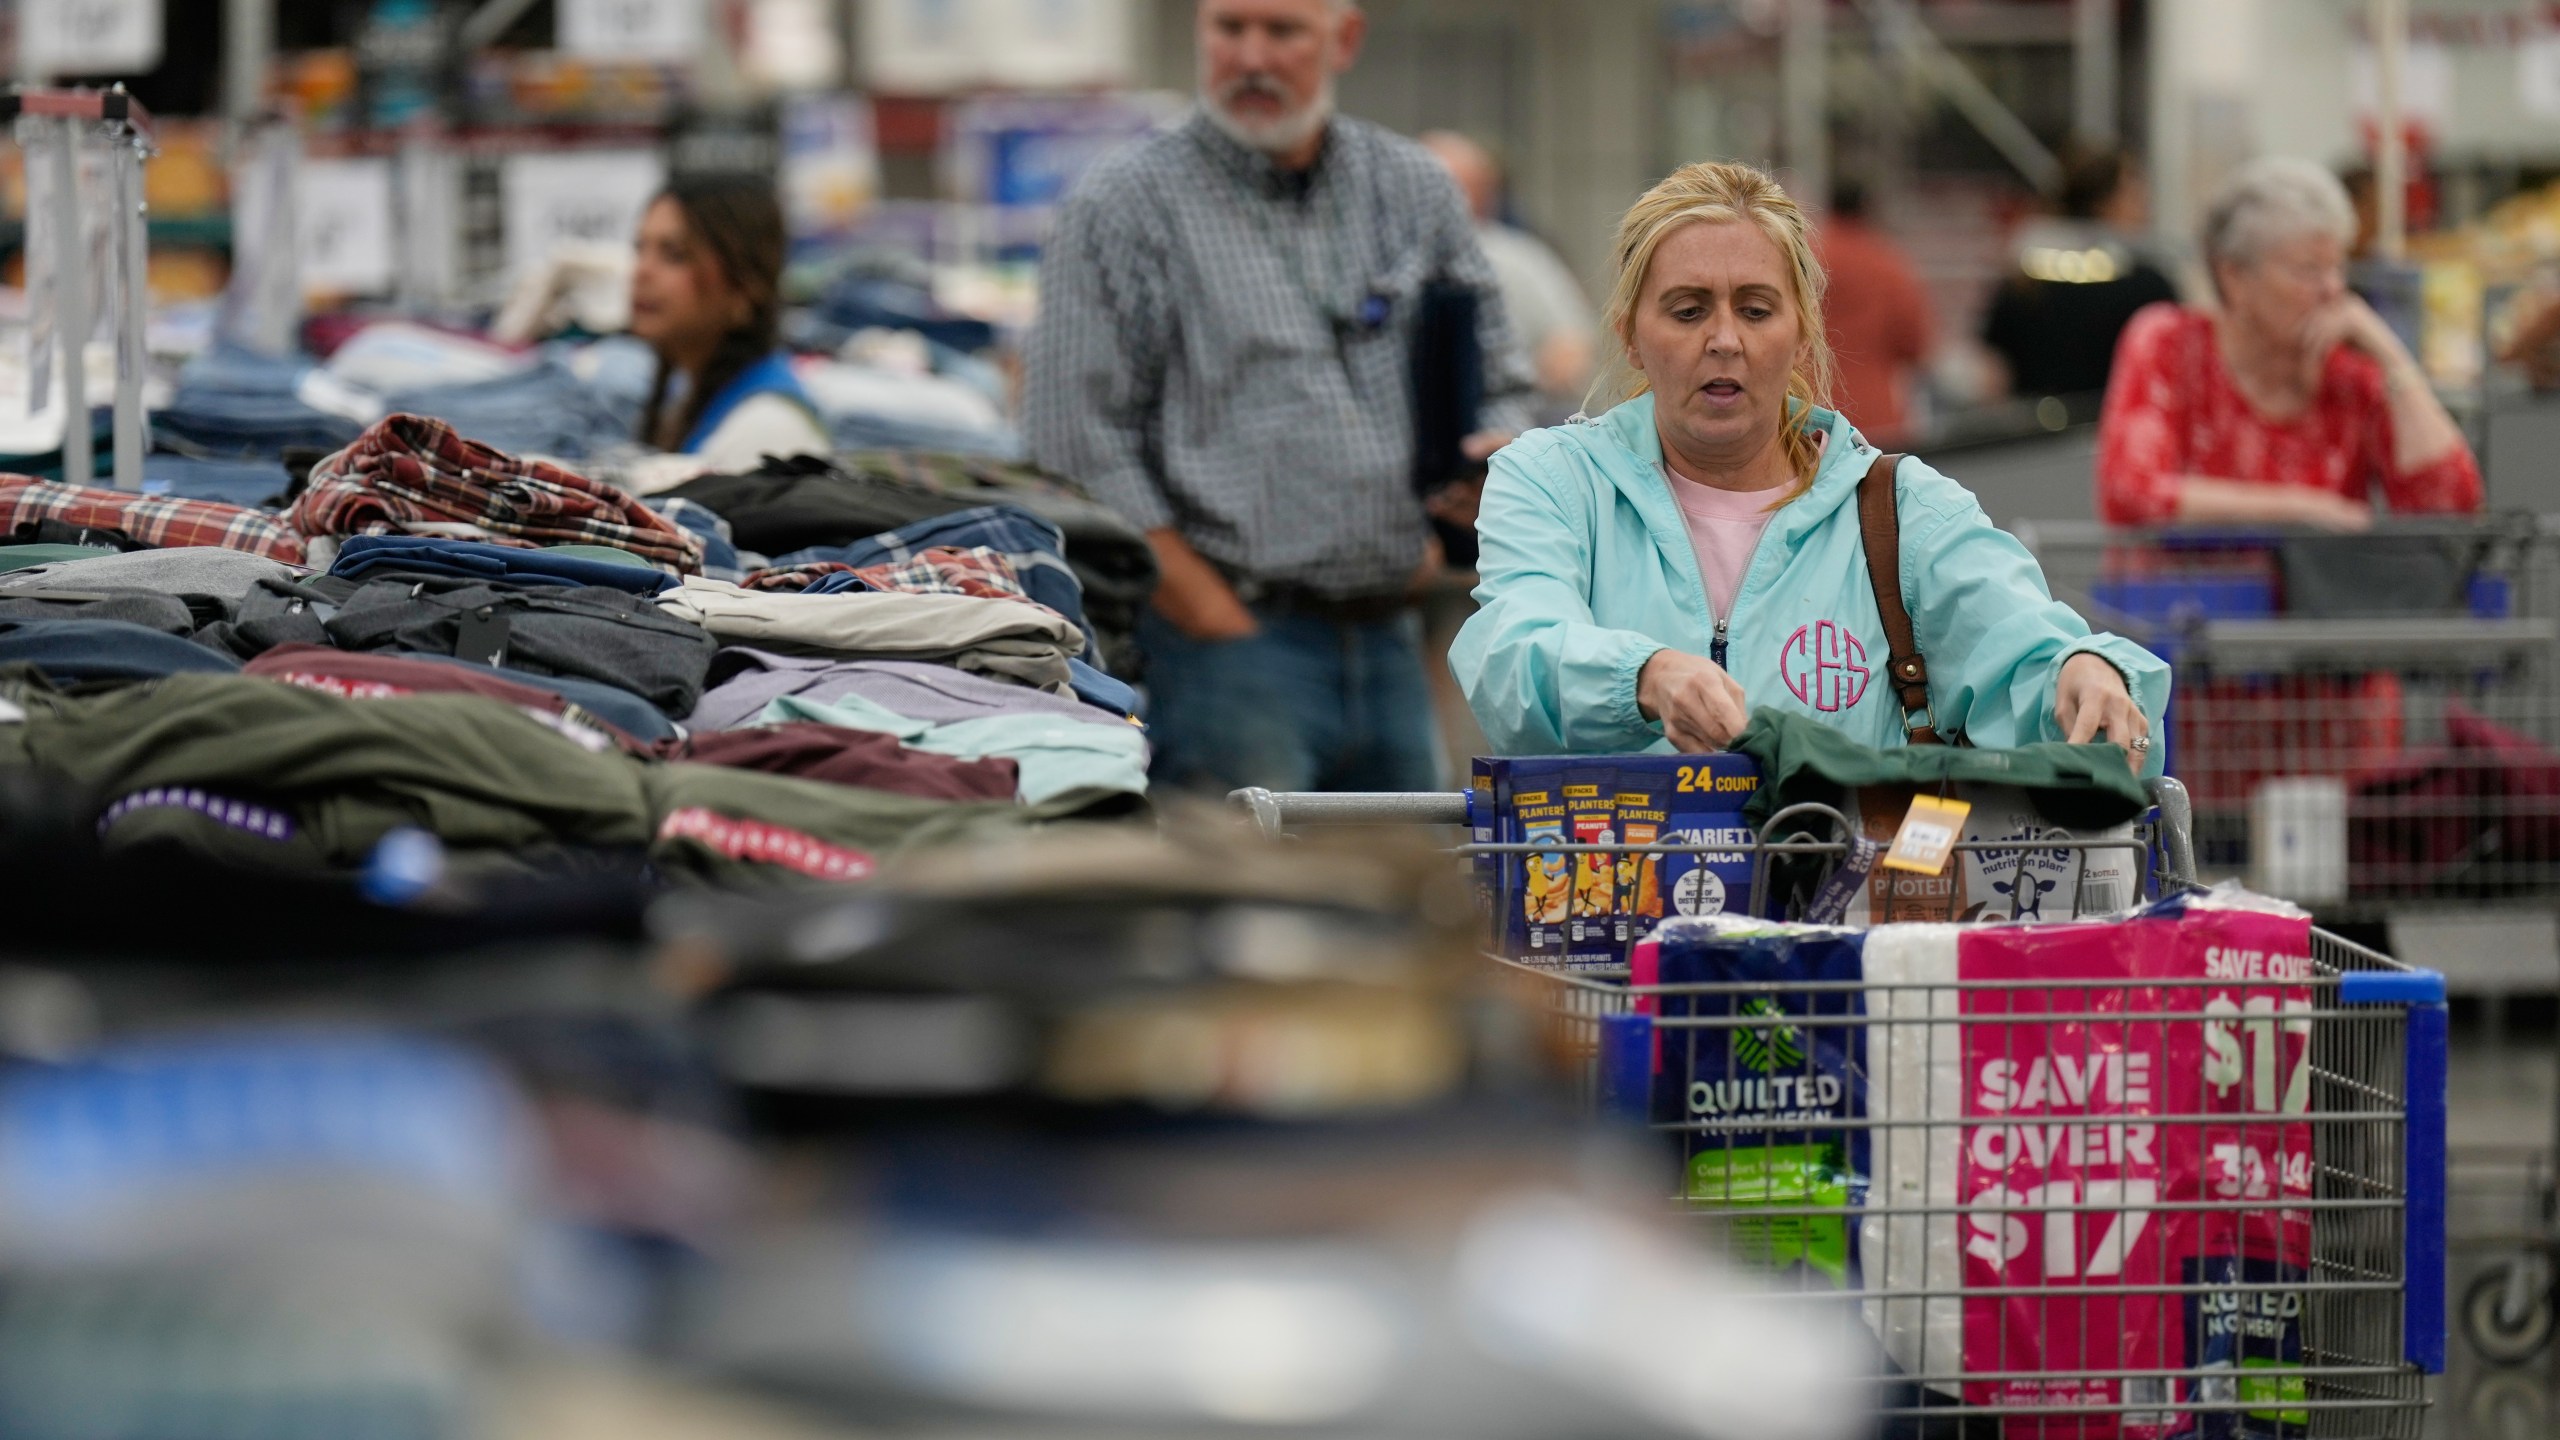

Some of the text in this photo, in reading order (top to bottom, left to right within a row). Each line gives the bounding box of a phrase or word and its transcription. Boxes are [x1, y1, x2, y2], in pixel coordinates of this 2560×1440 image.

[1677, 766, 1758, 792] 24 COUNT
[1519, 805, 1565, 819] PLANTERS
[1568, 799, 1616, 811] PLANTERS
[1617, 809, 1666, 822] PLANTERS
[1576, 822, 1608, 830] PEANUTS
[1677, 828, 1757, 846] VARIETY
[2038, 859, 2065, 873] plan
[2093, 869, 2119, 878] BOTTLES
[1874, 879, 1959, 896] PROTEIN
[2206, 947, 2263, 981] SAVE
[2205, 991, 2312, 1114] $17
[1978, 1053, 2150, 1111] SAVE
[1688, 1075, 1841, 1114] QUILTED
[1973, 1119, 2156, 1171] OVER
[1966, 1178, 2157, 1278] $17
